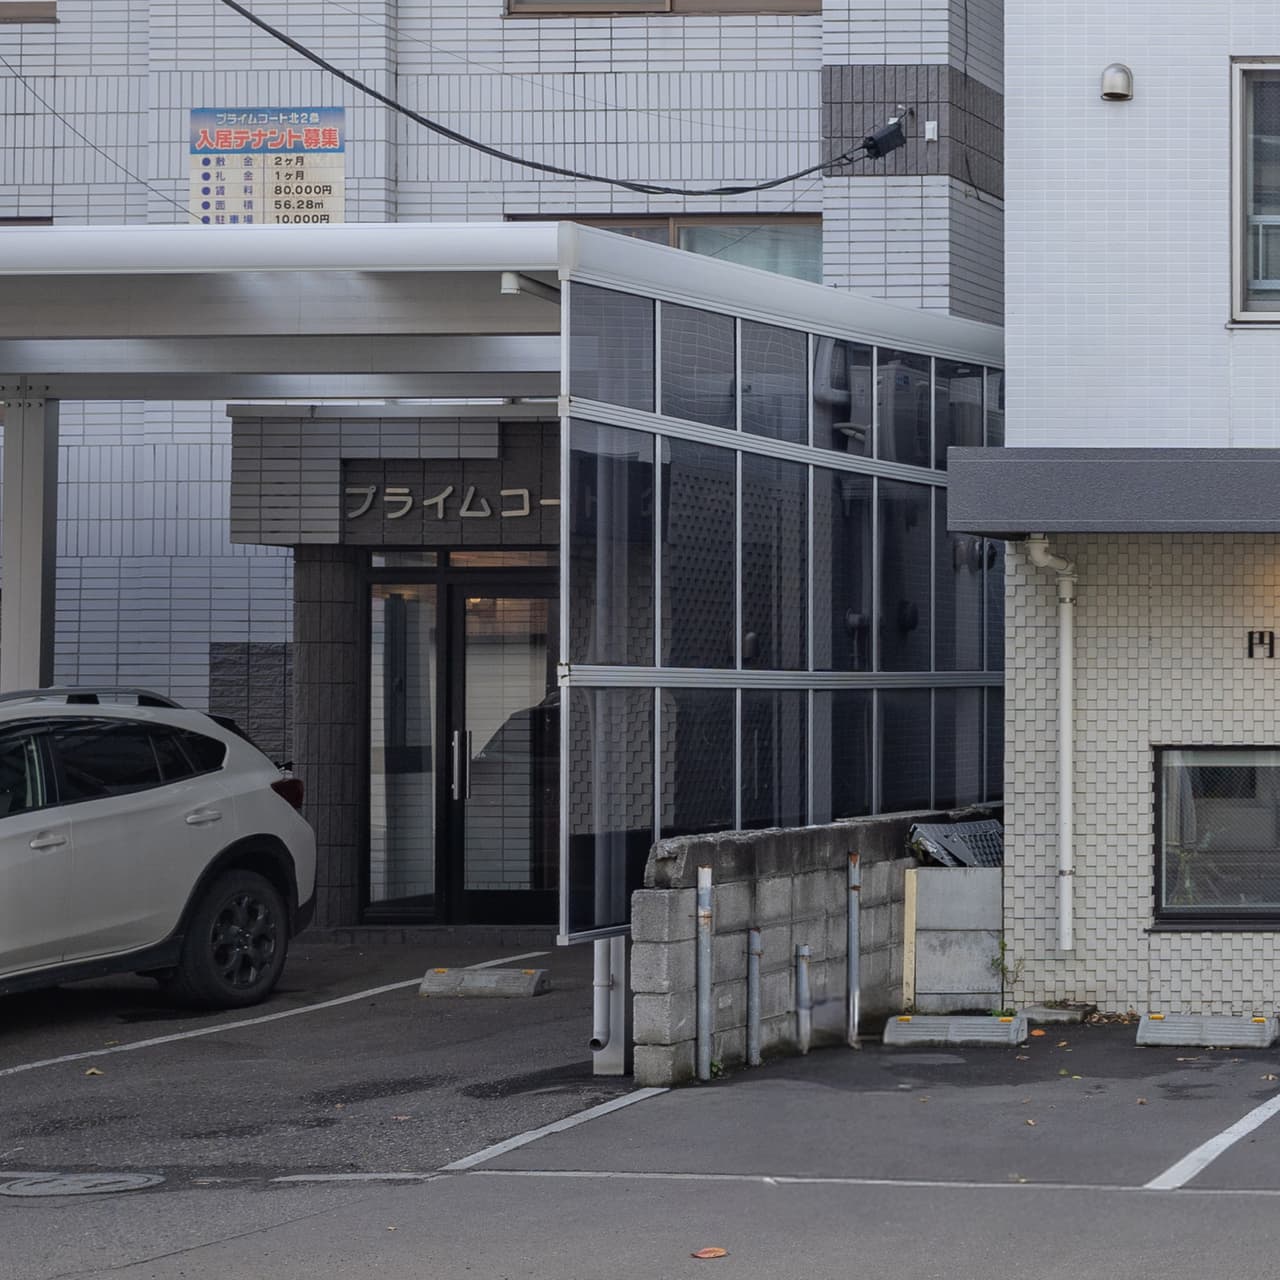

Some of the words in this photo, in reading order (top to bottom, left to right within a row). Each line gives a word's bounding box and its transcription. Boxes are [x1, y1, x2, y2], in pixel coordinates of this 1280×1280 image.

[195, 127, 340, 150] 入居テナント募集
